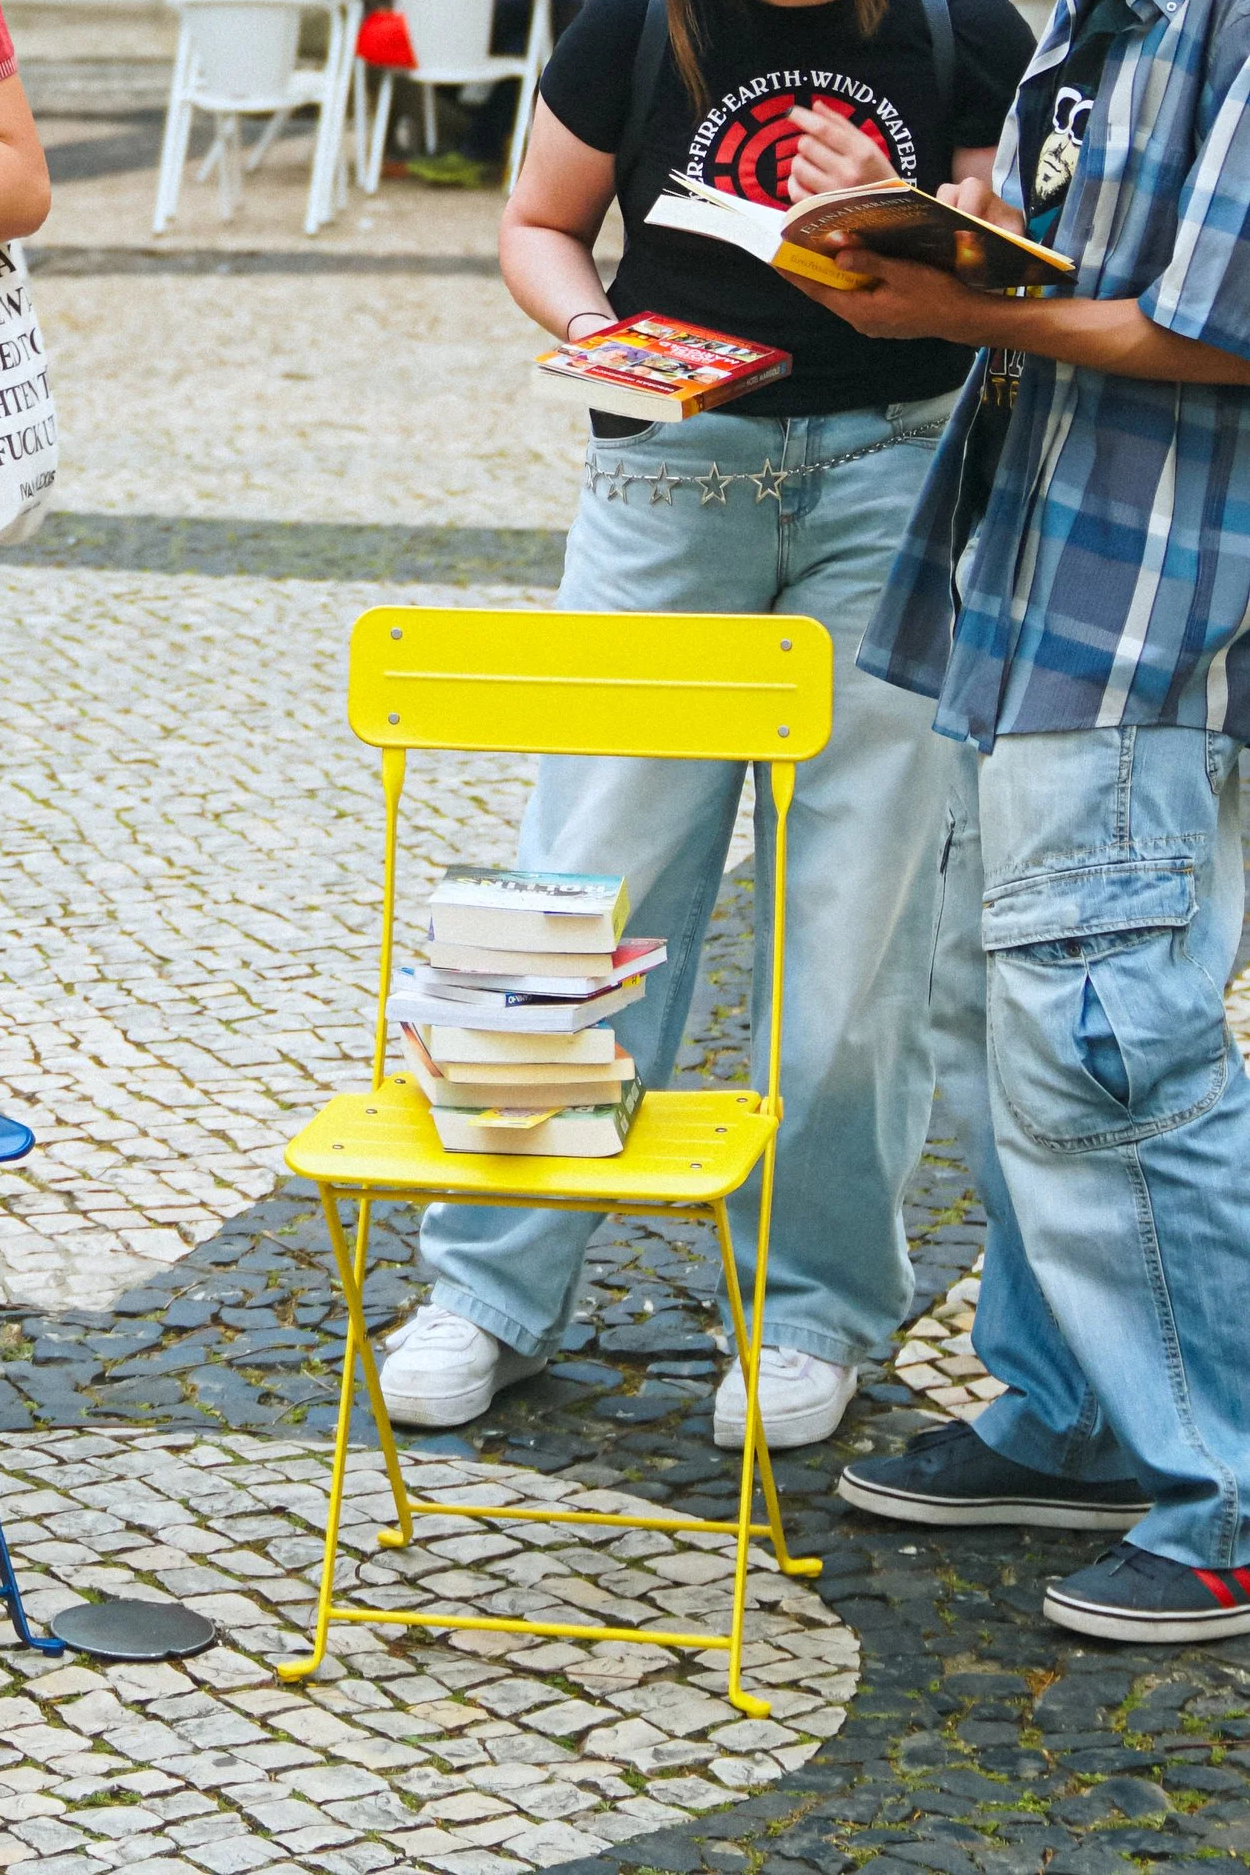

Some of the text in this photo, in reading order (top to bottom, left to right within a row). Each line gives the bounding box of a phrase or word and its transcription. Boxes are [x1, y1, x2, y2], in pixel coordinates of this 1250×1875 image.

[689, 69, 918, 173] FIRE EARTH WIND WATER
